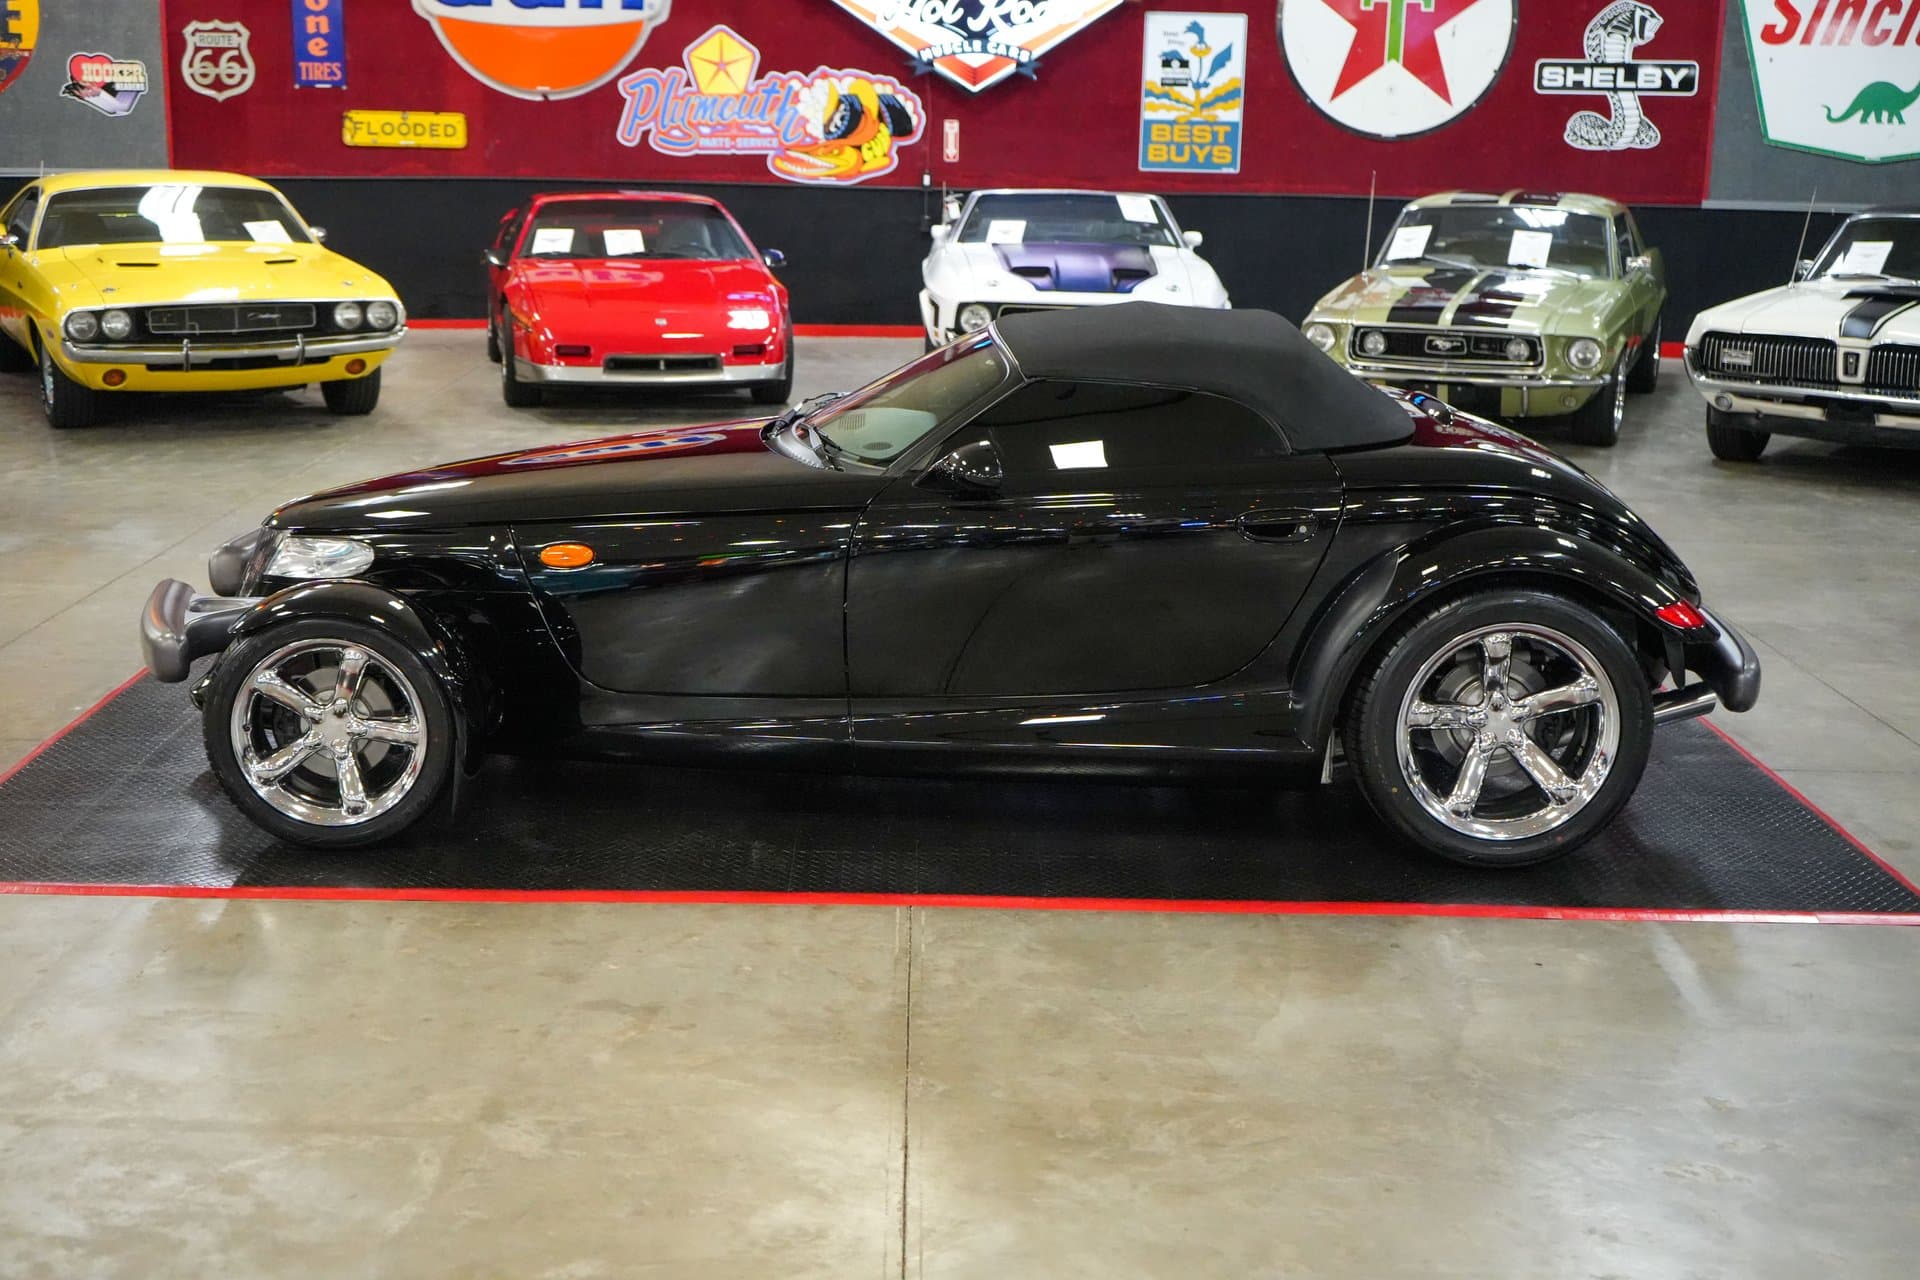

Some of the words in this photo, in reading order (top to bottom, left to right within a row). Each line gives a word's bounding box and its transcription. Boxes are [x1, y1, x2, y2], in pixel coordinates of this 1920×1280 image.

[1760, 0, 1920, 46] Sincl
[199, 34, 234, 46] ROUTE
[919, 39, 982, 62] MUSCLE
[987, 41, 1031, 63] CARS
[193, 49, 240, 86] 66
[299, 61, 342, 81] TIRES
[1540, 65, 1691, 90] SHELBY
[628, 75, 803, 147] Plymouth
[352, 120, 458, 139] FLOODED
[1151, 123, 1232, 144] BEST
[1147, 143, 1233, 164] BUYS
